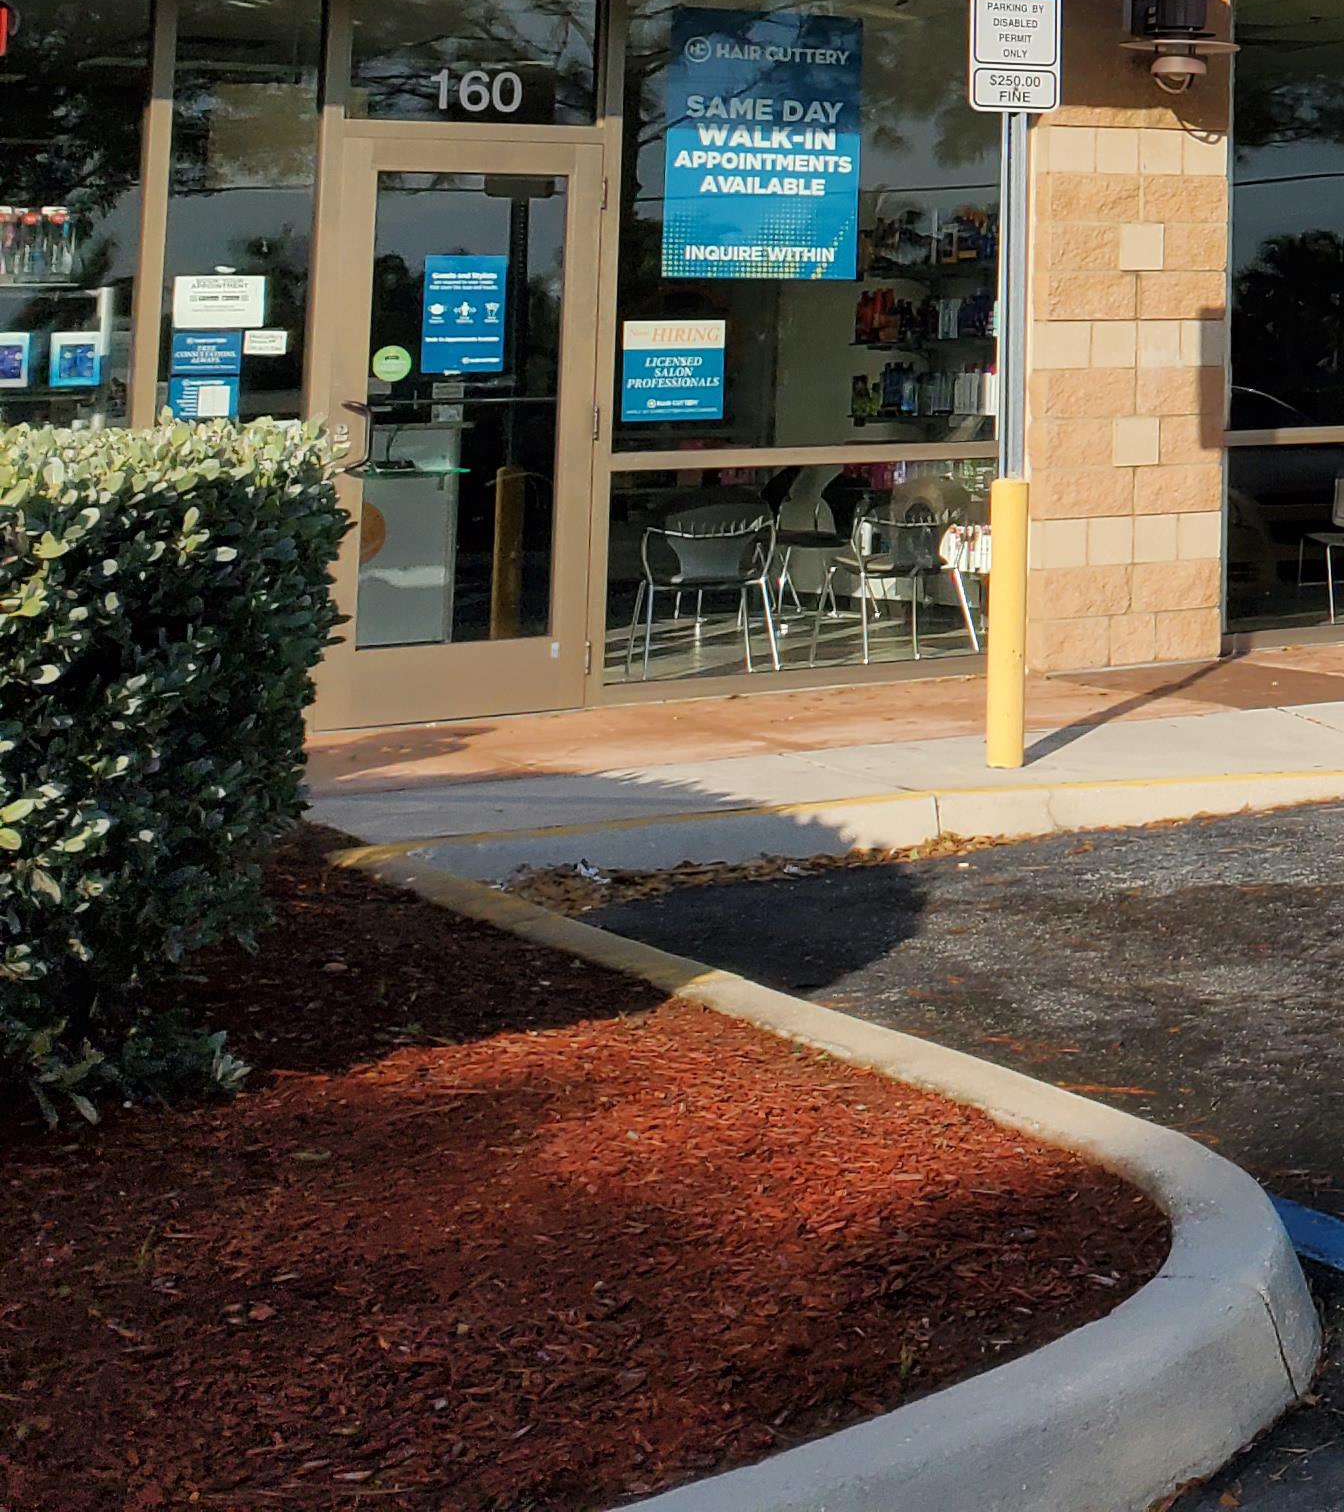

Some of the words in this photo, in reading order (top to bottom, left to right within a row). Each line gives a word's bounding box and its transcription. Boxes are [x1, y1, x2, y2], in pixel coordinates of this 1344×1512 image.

[987, 1, 1028, 14] PARKING
[1032, 3, 1045, 14] BY
[992, 17, 1039, 30] DISABLED
[998, 33, 1032, 44] PERMIT
[716, 42, 761, 61] HAIR
[764, 45, 850, 66] CUTTERY
[1002, 47, 1028, 59] ONLY
[429, 68, 523, 114] 160
[999, 90, 1032, 104] FINE
[685, 94, 774, 121] SAME
[782, 99, 844, 124] DAY
[697, 122, 837, 151] WALK-IN
[673, 149, 853, 174] APPOINTMENTS
[699, 174, 826, 196] AVAILABLE
[685, 244, 763, 261] INQUIRE
[767, 247, 835, 263] WITHIN
[651, 326, 721, 344] HIRING
[644, 356, 703, 368] LICENSED
[654, 366, 694, 378] SALON
[626, 377, 721, 389] PROFESSIONALS
